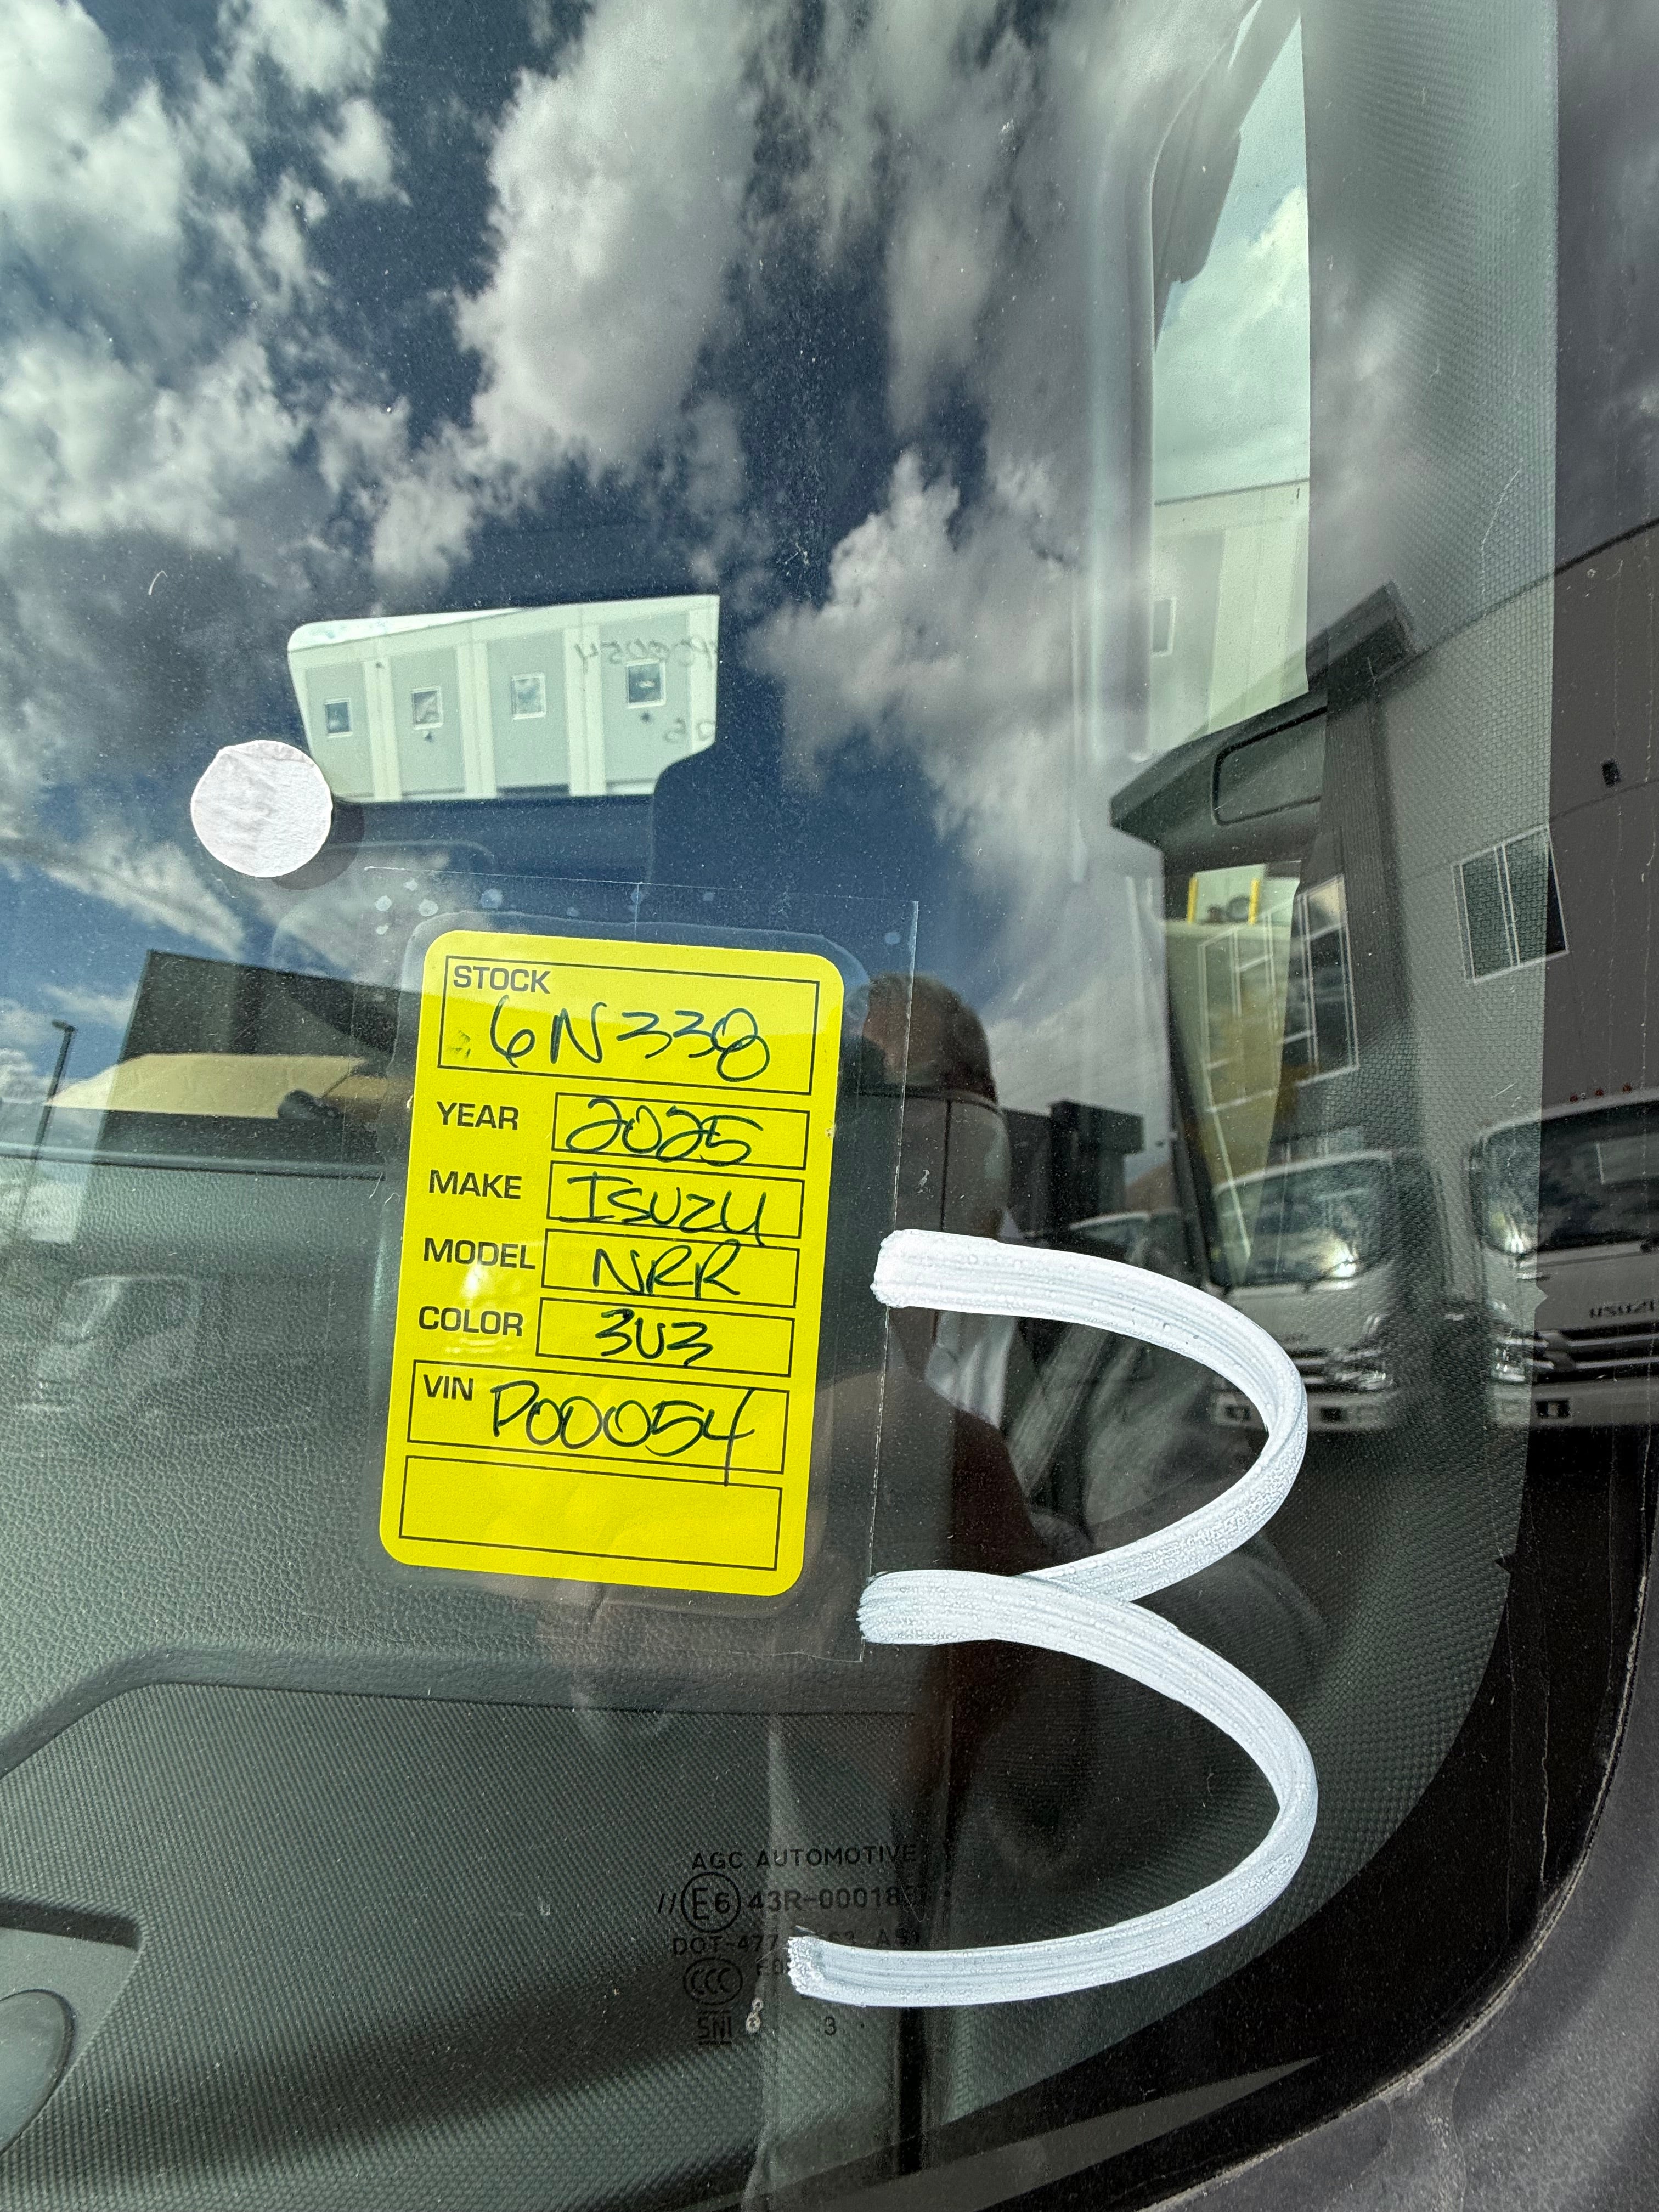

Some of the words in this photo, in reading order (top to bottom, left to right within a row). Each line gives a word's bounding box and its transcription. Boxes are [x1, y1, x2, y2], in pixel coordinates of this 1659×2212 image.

[453, 966, 551, 994] STOCK
[491, 995, 771, 1082] 6N338
[437, 1102, 520, 1131] YEAR
[566, 1096, 764, 1164] 2025
[429, 1169, 522, 1200] MAKE
[422, 1237, 537, 1271] MODEL
[592, 1239, 742, 1302] NRR
[418, 1306, 524, 1339] COLOR
[424, 1375, 473, 1401] VIN
[490, 1380, 757, 1487] P00054
[786, 1228, 1318, 2008] 3
[692, 1851, 743, 1870] AGC
[756, 1844, 917, 1868] AUTOMOTIVE
[692, 1887, 730, 1920] E6
[698, 2016, 733, 2039] SNI
